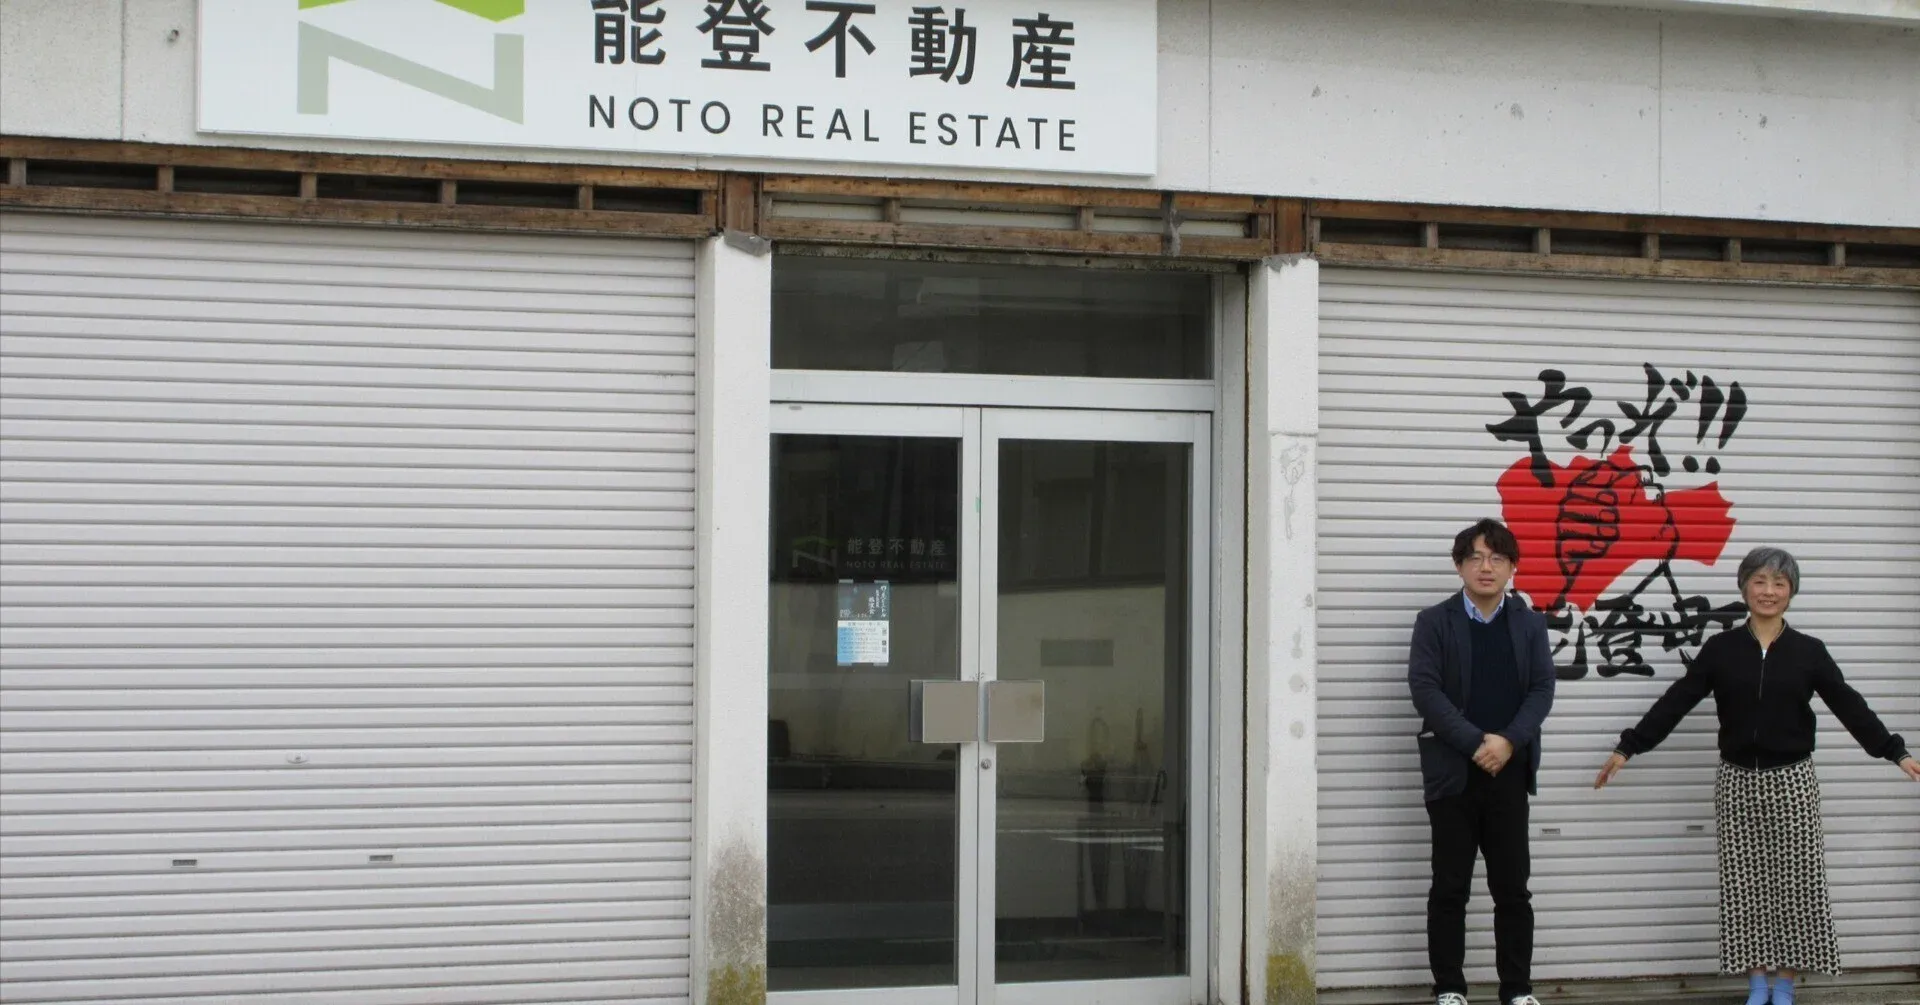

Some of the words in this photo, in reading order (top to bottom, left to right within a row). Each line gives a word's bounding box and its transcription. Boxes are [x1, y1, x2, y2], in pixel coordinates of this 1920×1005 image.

[590, 0, 1077, 90] 能登不動産
[588, 94, 732, 135] NOTO
[761, 103, 880, 143] REAL
[909, 111, 1077, 152] ESTATE
